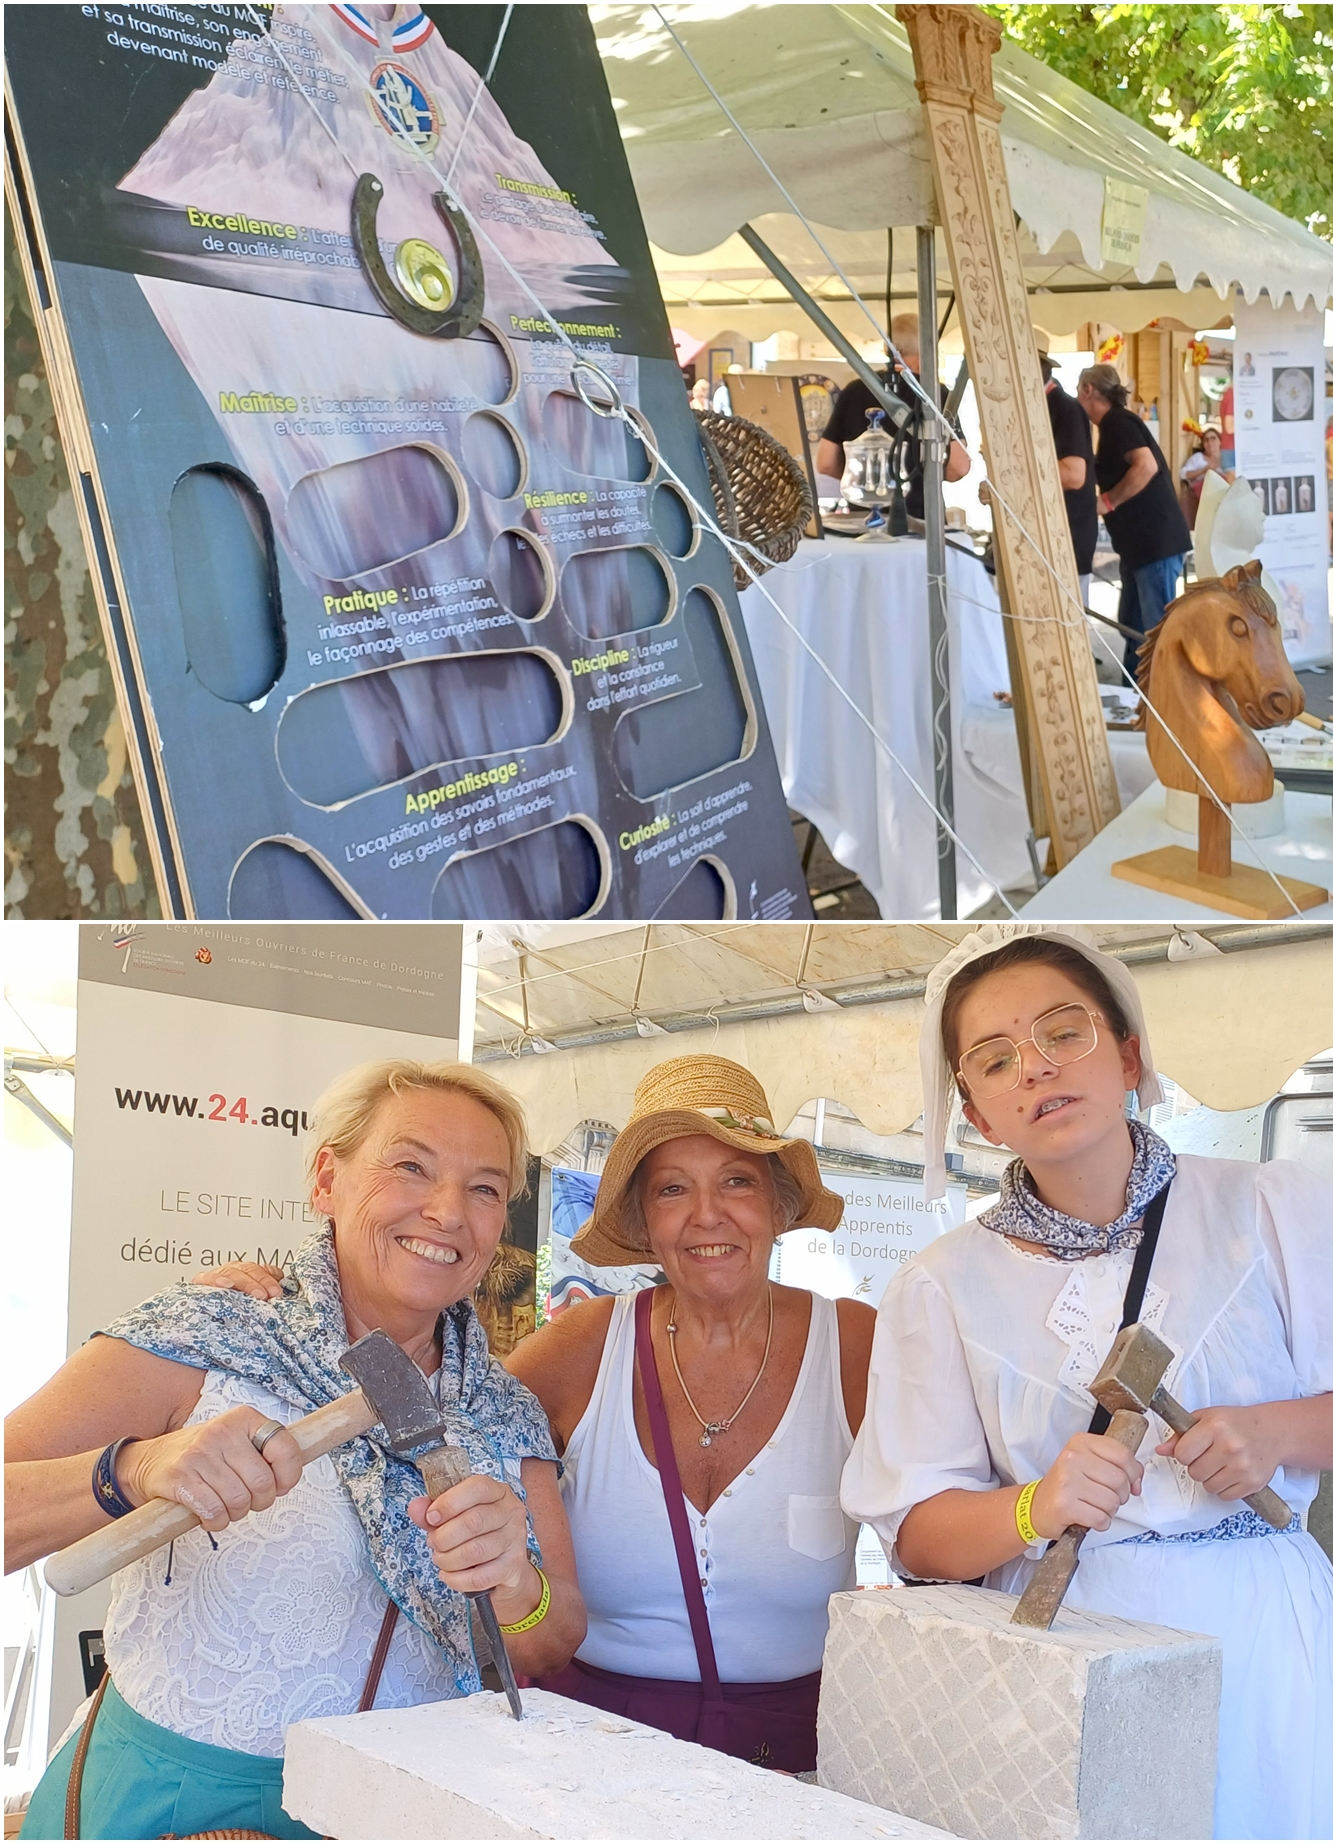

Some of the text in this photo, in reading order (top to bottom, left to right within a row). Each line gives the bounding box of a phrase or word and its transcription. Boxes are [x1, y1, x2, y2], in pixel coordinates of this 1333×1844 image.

[203, 18, 322, 63] son engagement
[211, 5, 317, 43] du inspire.
[82, 5, 99, 19] et
[105, 12, 124, 26] sa
[128, 16, 223, 53] transmission
[305, 66, 349, 89] métier.
[107, 31, 269, 85] devenant modèle et
[495, 173, 570, 203] Transmission
[186, 206, 298, 240] Excellence
[203, 235, 279, 259] de qualité
[218, 390, 298, 415] Maîtrise
[312, 395, 393, 417] L'acquisition
[275, 417, 448, 436] et d'une technique solides.
[524, 486, 647, 509] Résilience La capacité
[550, 507, 610, 526] surmonter les
[587, 526, 596, 538] et
[597, 524, 611, 536] les
[323, 577, 486, 616] Pratique La répétition
[318, 596, 499, 641] inlassable, l'expérimentation,
[306, 612, 515, 667] le façonnage des compétences.
[572, 638, 678, 676] Discipline La rigueur
[619, 661, 664, 682] constance
[587, 672, 682, 711] dans l'effort quotidien.
[405, 761, 518, 815] Apprentissage
[344, 820, 429, 862] L'acquisition
[430, 811, 454, 830] des
[455, 795, 496, 819] savoirs
[388, 795, 555, 870] des gestes des méthodes.
[701, 800, 748, 832] comprendre
[166, 924, 444, 981] Les Meilleurs Ouvriers de France de Dordogne
[114, 1087, 309, 1137] www.24.aqu
[160, 1189, 252, 1218] LE SITE
[846, 1190, 947, 1215] des Meilleurs
[838, 1216, 913, 1236] Apprentis
[120, 1237, 247, 1266] dédié aux
[808, 1238, 918, 1265] de la Dordogn
